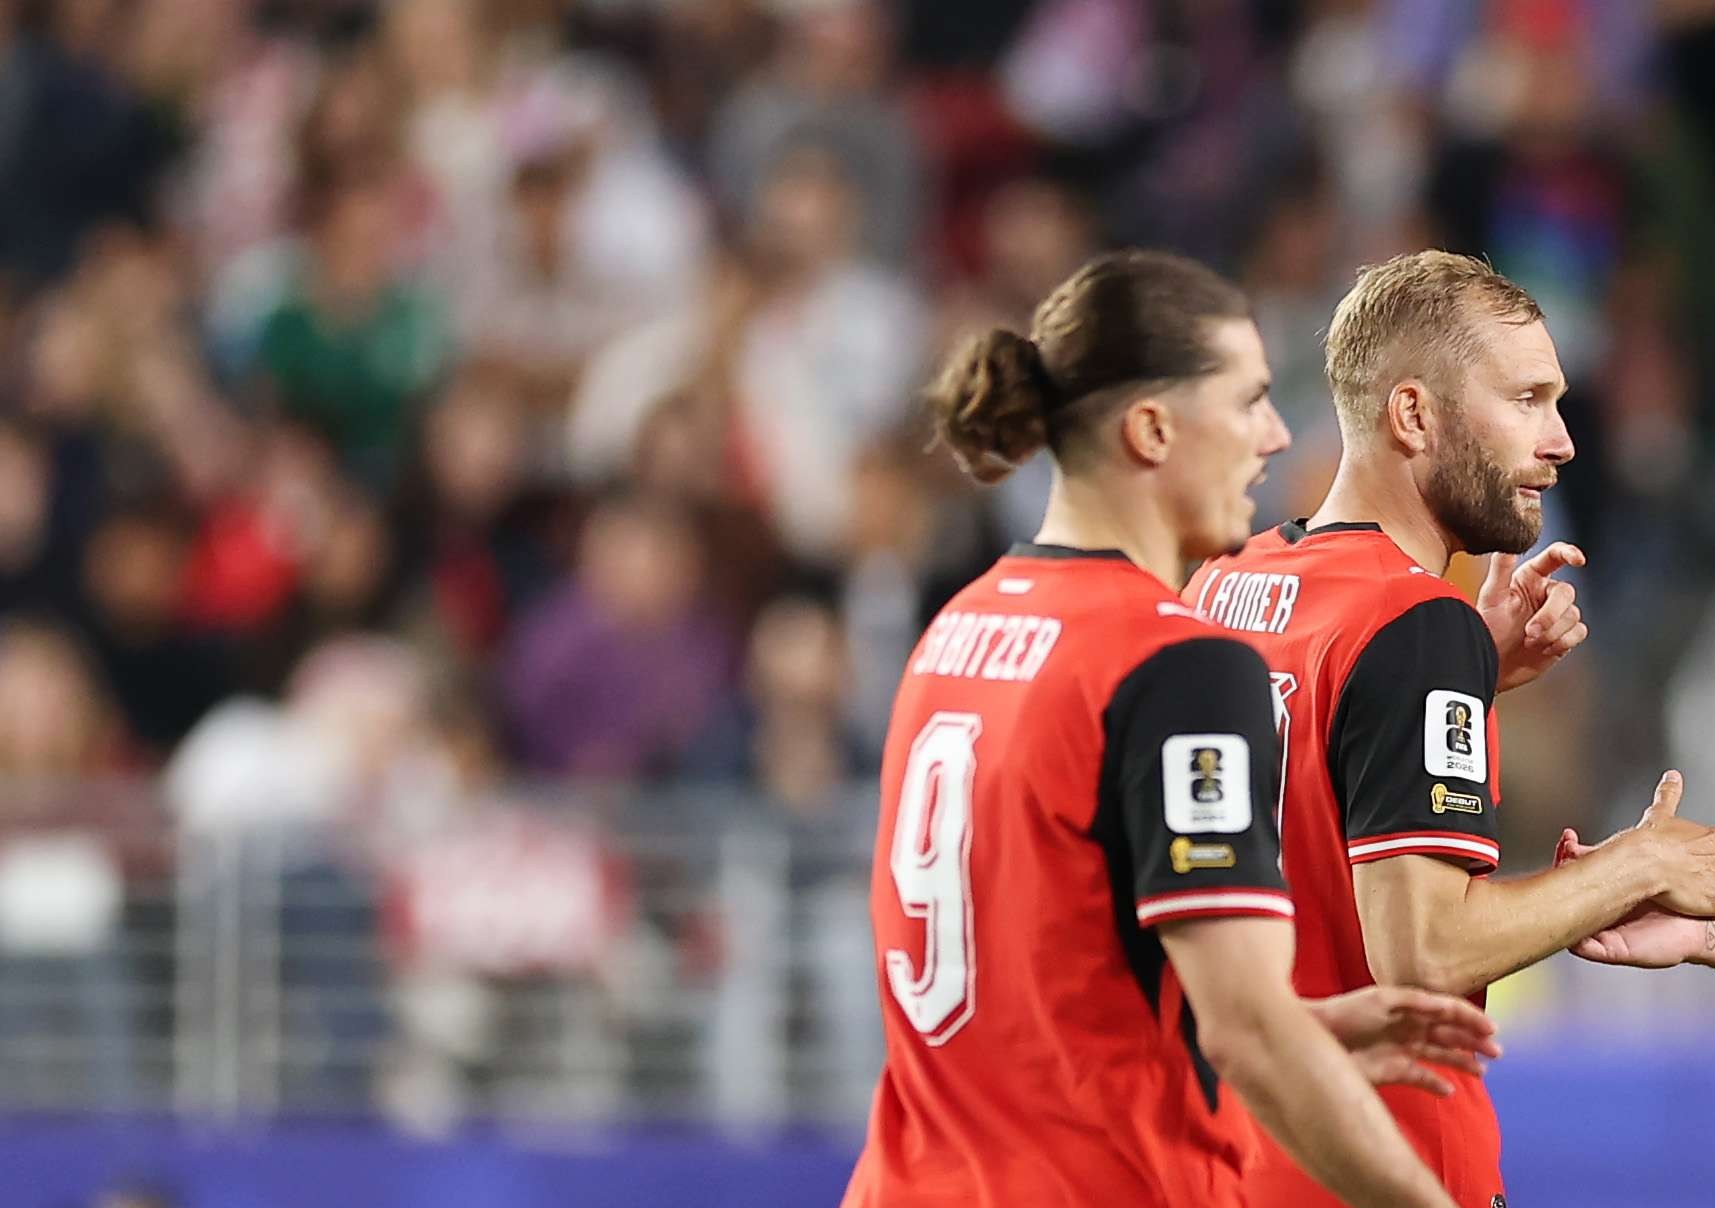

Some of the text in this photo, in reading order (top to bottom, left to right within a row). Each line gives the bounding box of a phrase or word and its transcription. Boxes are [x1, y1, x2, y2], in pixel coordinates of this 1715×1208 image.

[1195, 568, 1300, 634] LAIMER
[1445, 795, 1478, 807] DEBUT
[886, 711, 983, 1047] 9
